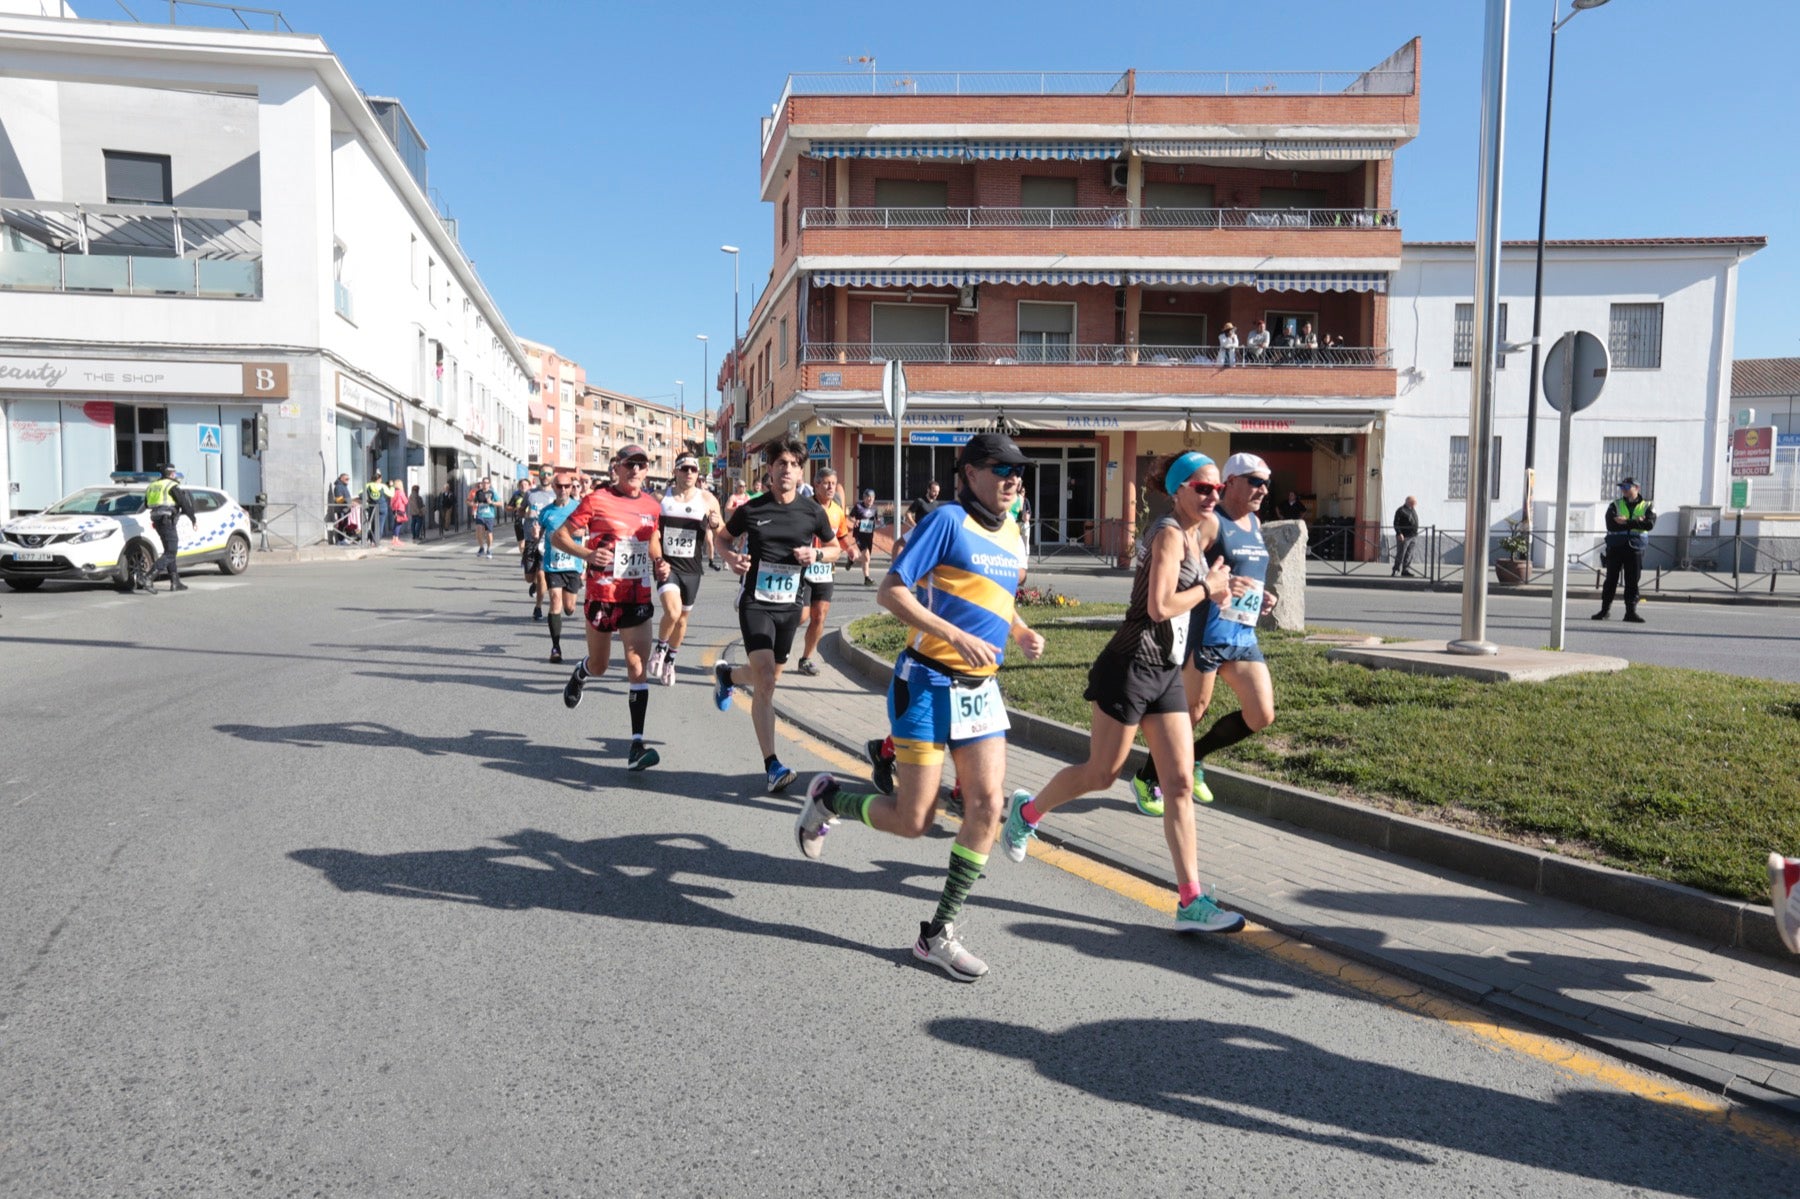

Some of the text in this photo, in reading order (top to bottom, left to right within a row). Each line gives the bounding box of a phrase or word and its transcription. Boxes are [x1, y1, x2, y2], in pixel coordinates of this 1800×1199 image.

[83, 372, 115, 382] THE
[122, 373, 164, 384] SHOP
[256, 368, 275, 390] B
[1066, 416, 1119, 427] PARADA
[911, 434, 940, 442] Granada
[667, 536, 693, 548] 3123
[620, 553, 647, 565] 3176
[808, 564, 831, 574] 1037
[765, 575, 793, 591] 116
